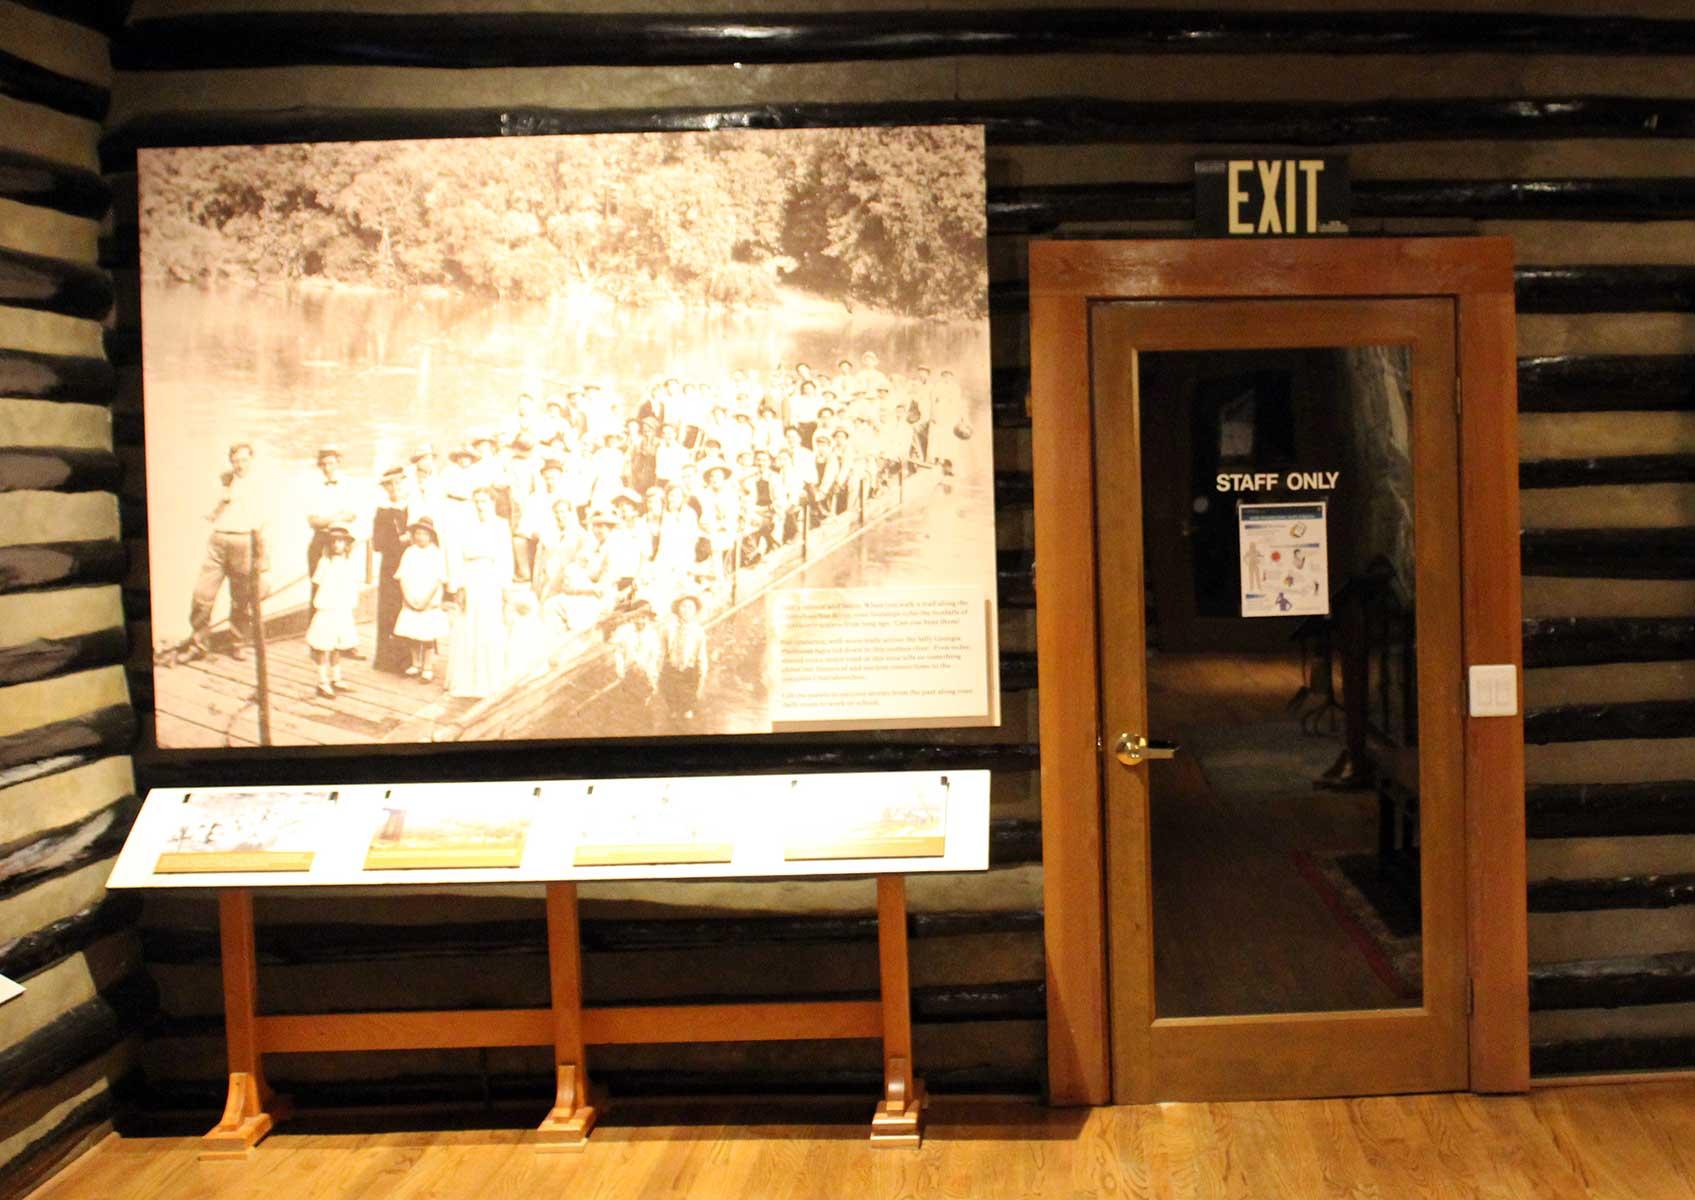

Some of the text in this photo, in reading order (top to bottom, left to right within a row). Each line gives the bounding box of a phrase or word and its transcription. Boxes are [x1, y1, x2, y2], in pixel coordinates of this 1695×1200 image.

[1228, 160, 1325, 234] EXIT
[1216, 472, 1340, 492] STAFF ONLY
